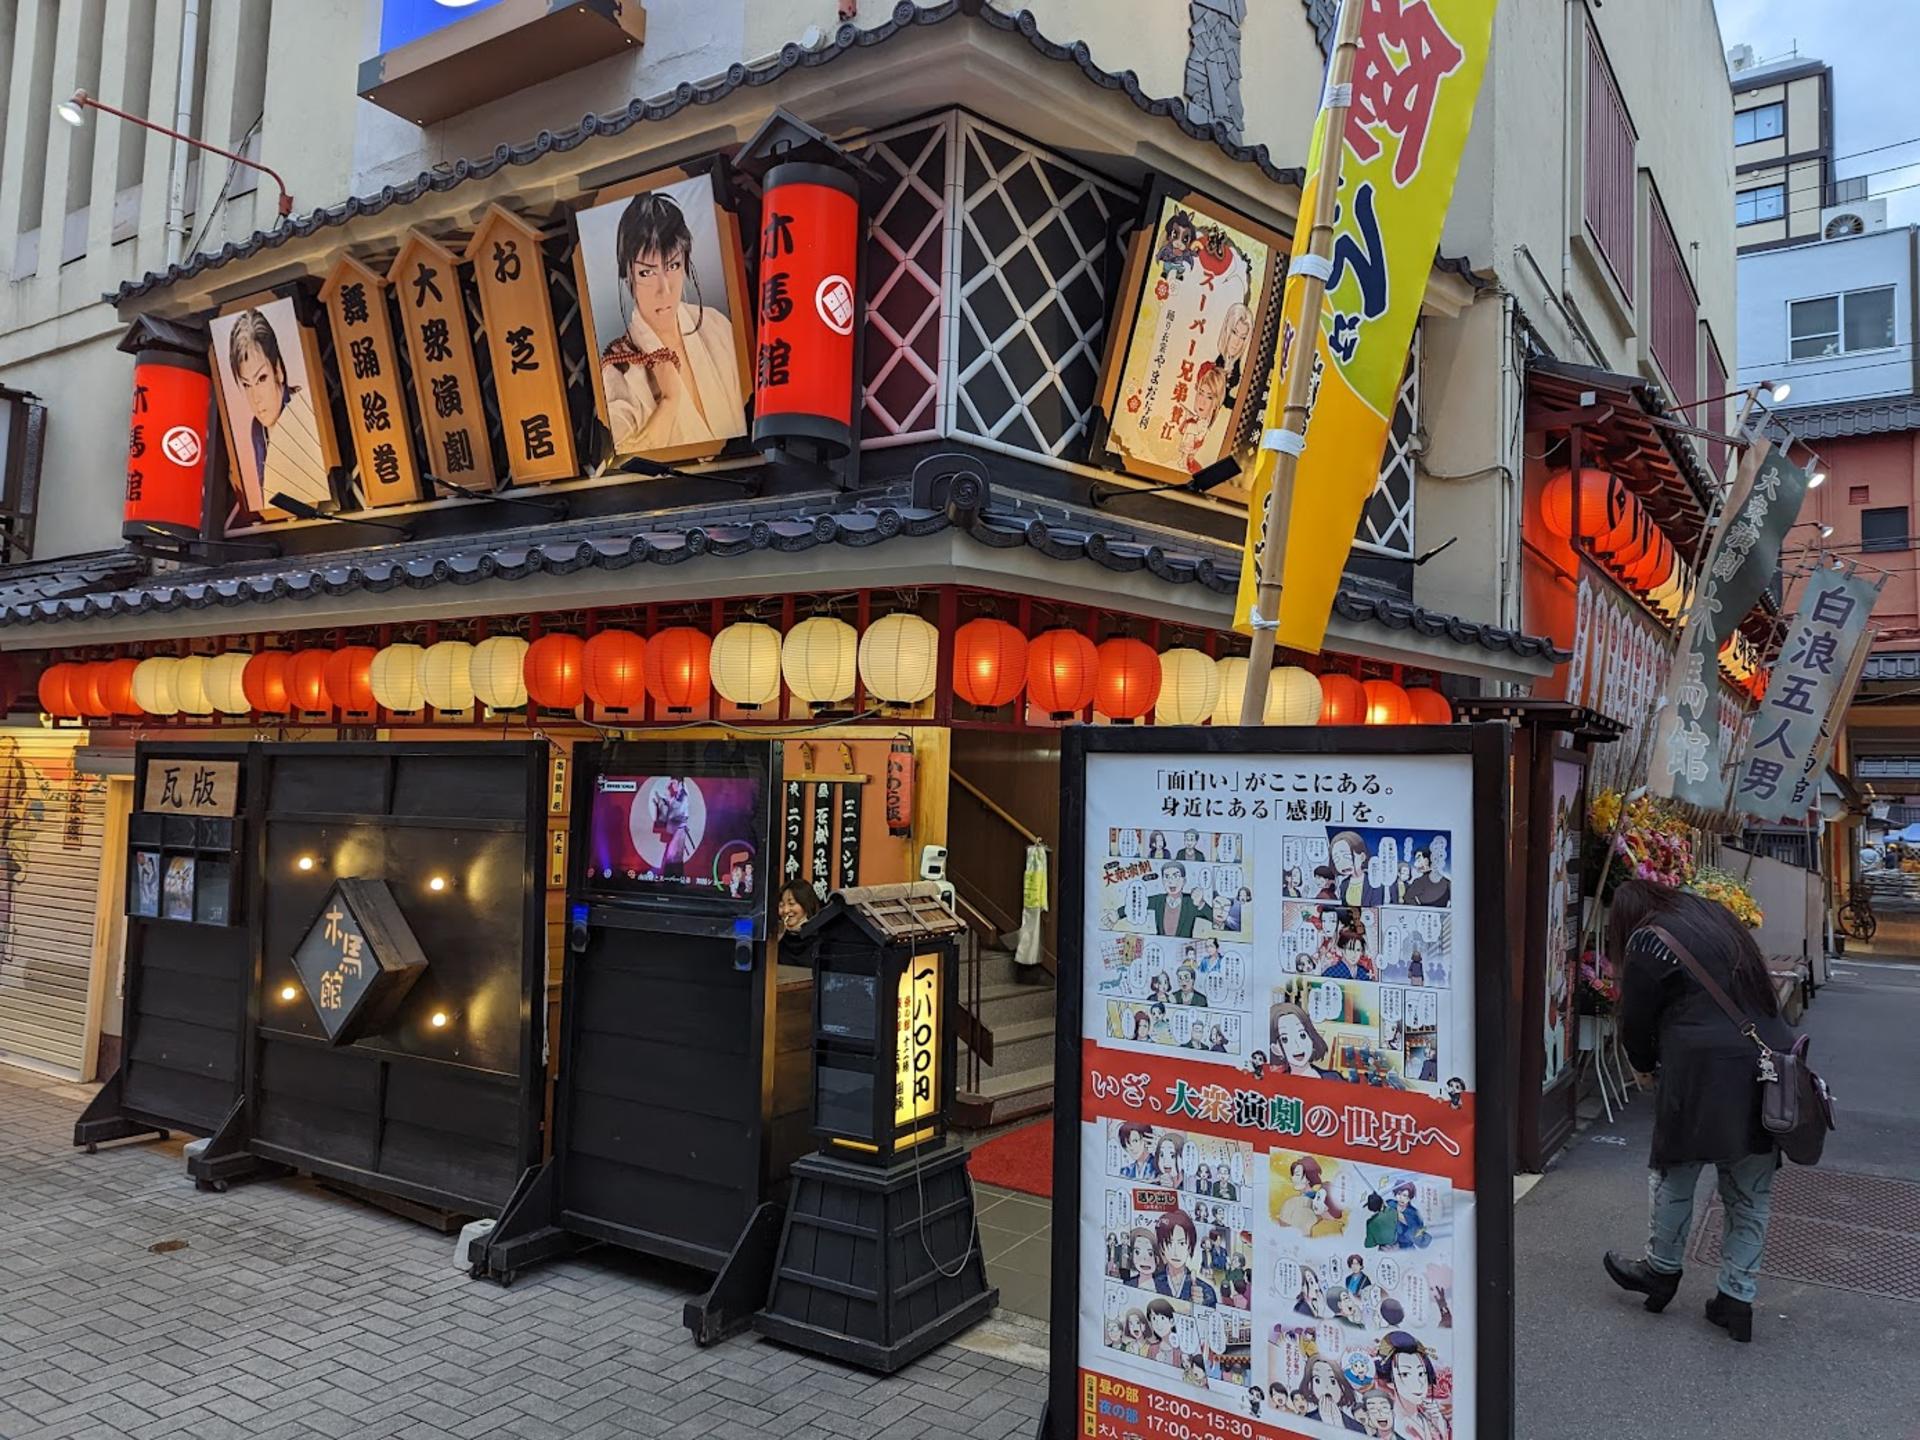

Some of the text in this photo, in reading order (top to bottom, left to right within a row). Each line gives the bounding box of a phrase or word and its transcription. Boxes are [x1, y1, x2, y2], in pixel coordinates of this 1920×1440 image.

[493, 240, 555, 461] お芝居
[758, 212, 794, 392] 木馬館
[340, 283, 401, 484] 舞踊絵巻
[413, 263, 474, 474] 大衆演劇
[1711, 465, 1782, 584] 大衆演劇
[1665, 579, 1723, 785] 木馬館
[1739, 585, 1856, 801] 白浪五人男
[160, 766, 218, 808] 瓦版
[1156, 769, 1393, 796] 「面白い」がここにある。
[1160, 796, 1386, 824] 身近にある「感動」を。
[320, 904, 364, 1010] 木馬館
[1091, 1070, 1461, 1157] いざ、大衆演劇の世界へ
[1098, 1399, 1139, 1425] 夜の部
[1098, 1423, 1119, 1439] 大人
[1099, 1378, 1252, 1438] 昼の部 12:00~15:30
